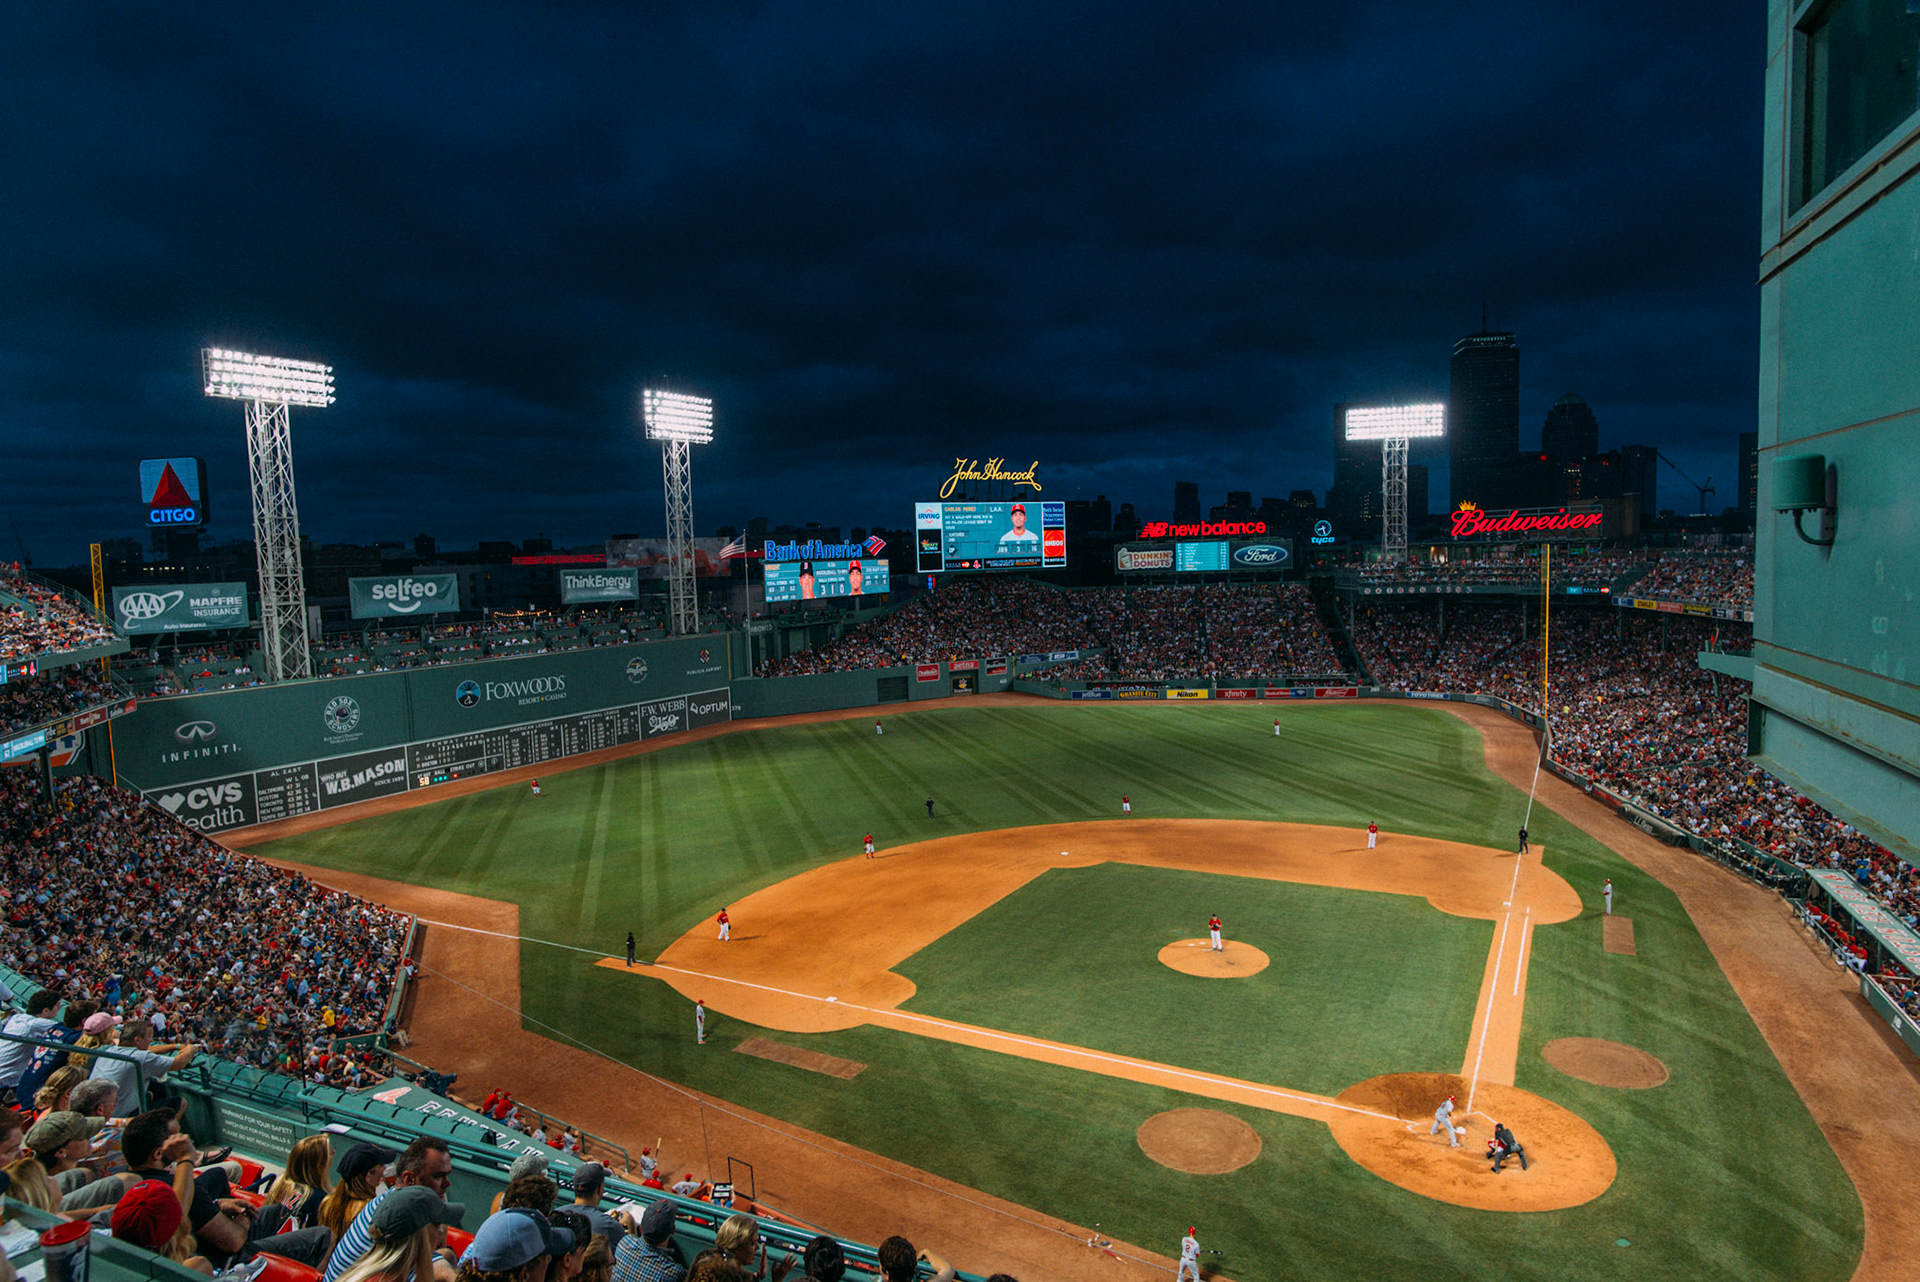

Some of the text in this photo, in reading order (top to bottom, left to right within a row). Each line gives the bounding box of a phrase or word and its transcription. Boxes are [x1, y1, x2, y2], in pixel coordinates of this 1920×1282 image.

[940, 458, 1042, 498] John Hancock
[150, 508, 195, 524] CITGO
[1451, 508, 1602, 536] Budweiser
[1169, 523, 1200, 538] new
[1201, 520, 1266, 536] balance
[765, 539, 863, 560] Bank of America
[1244, 548, 1276, 562] Ford
[1134, 559, 1172, 568] DONUTS
[372, 578, 437, 601] selfeo
[565, 576, 631, 589] ThinkEnergy
[821, 585, 826, 595] 3
[840, 584, 844, 593] 0
[126, 594, 161, 617] AAA
[190, 596, 242, 607] MAPFRE
[194, 608, 240, 617] INSURANCE
[486, 675, 566, 701] FOXWOODS
[519, 692, 567, 705] RESORT CASINO
[326, 697, 353, 716] RED SOX
[640, 699, 685, 717] F.W. WEBB
[699, 701, 727, 714] OPTUM
[328, 709, 359, 731] SCHOLARS
[510, 725, 534, 733] AMERICAN
[162, 743, 237, 763] INFINITI
[320, 770, 347, 782] WHO BUT
[325, 759, 405, 795] W.B.MASON
[374, 778, 390, 786] SINCE
[187, 782, 242, 809] CVS
[258, 786, 285, 795] BALTIMORE
[259, 793, 279, 802] BOSTON
[260, 799, 284, 808] TORONTO
[221, 1108, 244, 1120] WARNING
[256, 1120, 271, 1130] YOUR
[271, 1124, 293, 1134] SAFETY
[224, 1120, 238, 1128] WATCH
[222, 1128, 238, 1138] PLEASE
[256, 1139, 270, 1148] REACH
[1186, 1244, 1190, 1253] 2
